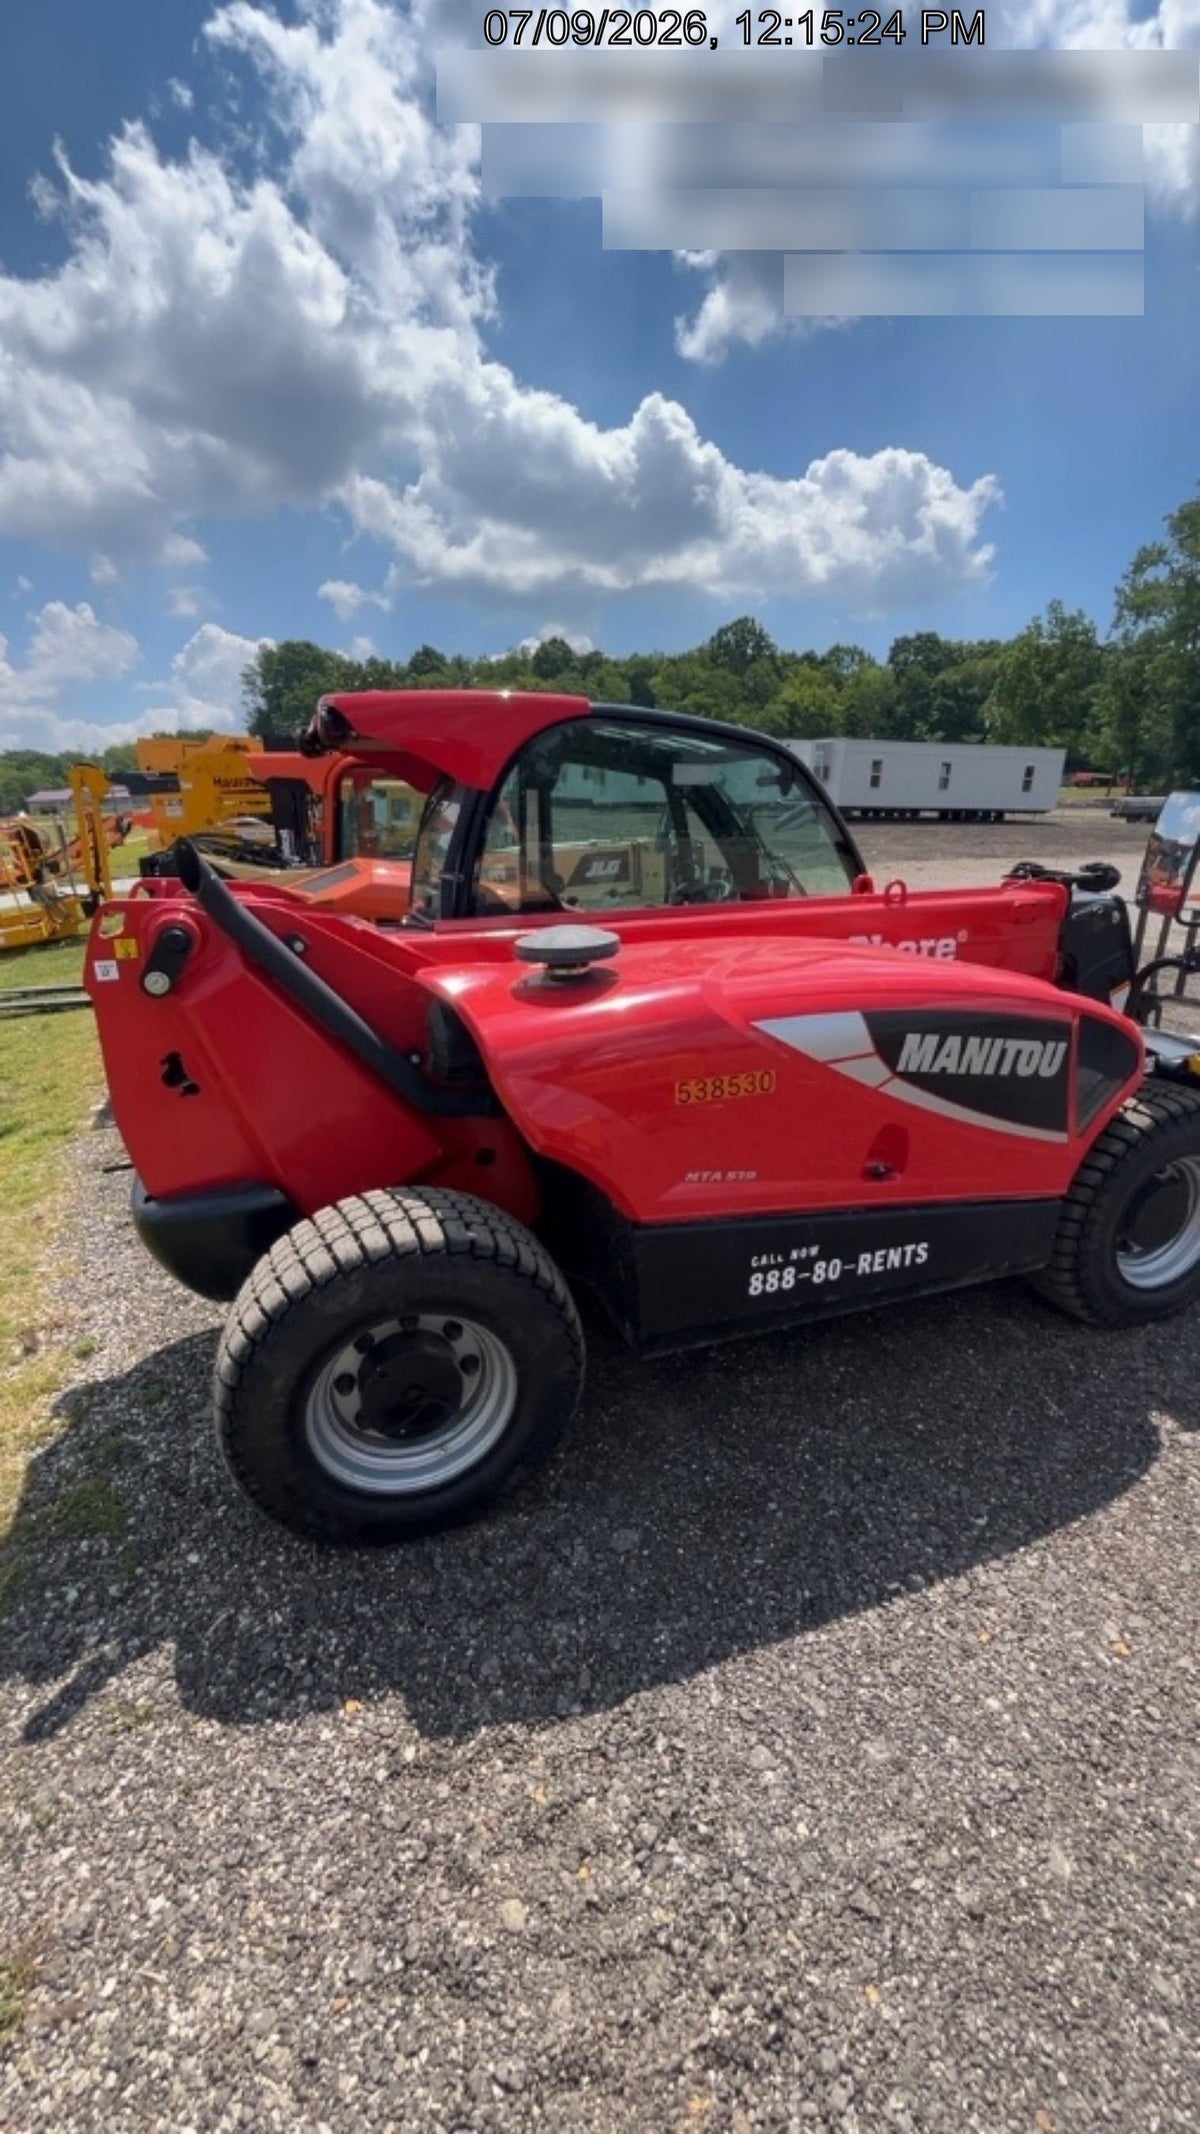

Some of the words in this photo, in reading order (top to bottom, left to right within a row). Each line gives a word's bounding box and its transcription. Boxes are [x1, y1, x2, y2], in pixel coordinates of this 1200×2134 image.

[896, 1033, 1068, 1077] MANITOU
[678, 1071, 772, 1103] 538530
[749, 1242, 929, 1296] 888-80-RENTS
[751, 1253, 784, 1267] CALL
[789, 1244, 820, 1260] NOW
